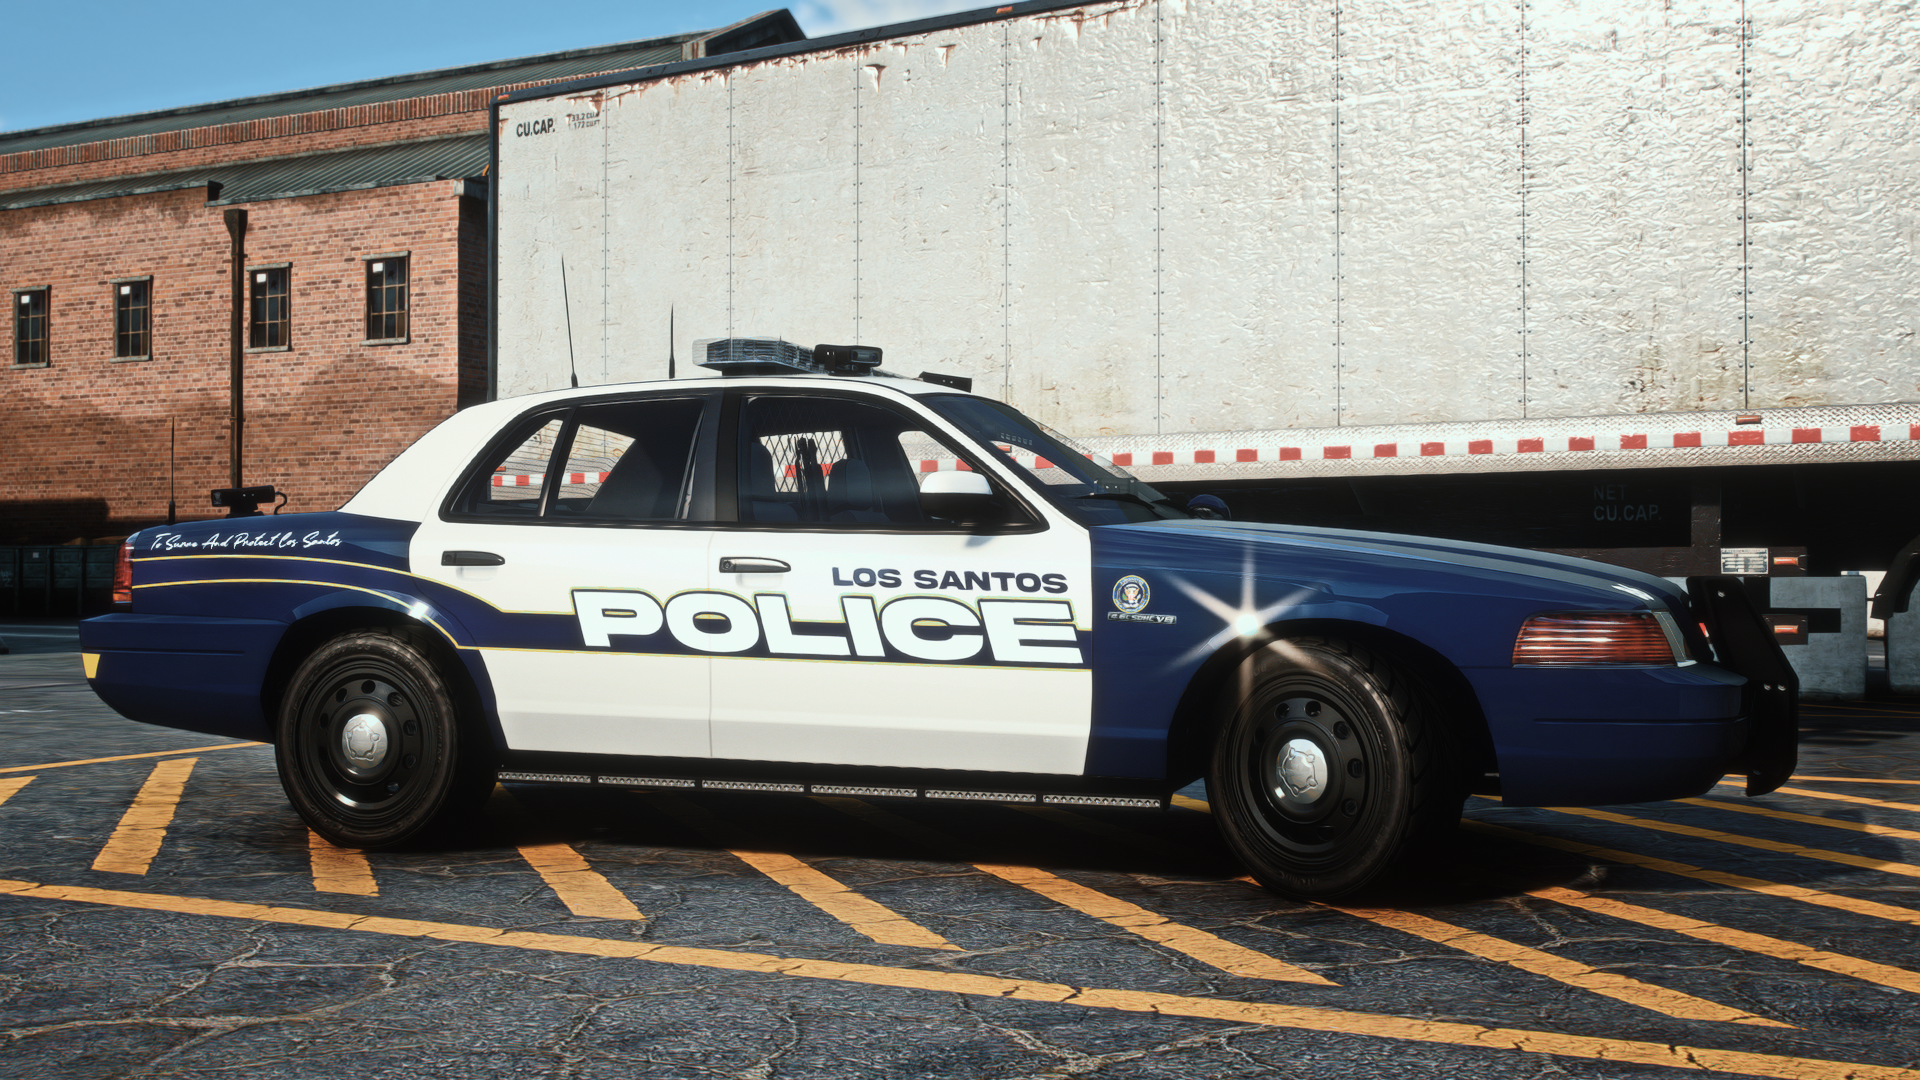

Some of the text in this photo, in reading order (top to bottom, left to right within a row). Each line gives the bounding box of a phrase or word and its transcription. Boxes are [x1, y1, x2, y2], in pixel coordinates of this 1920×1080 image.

[516, 118, 555, 137] CU.CAP.
[1593, 484, 1627, 500] NET
[1593, 504, 1661, 521] CU.CAP.
[150, 532, 171, 551] To
[201, 532, 234, 550] And
[233, 531, 282, 550] Protect
[302, 530, 342, 549] Santos
[831, 566, 1069, 594] LOS SANTOS
[571, 588, 1084, 664] POLICE
[1156, 615, 1174, 624] V8
